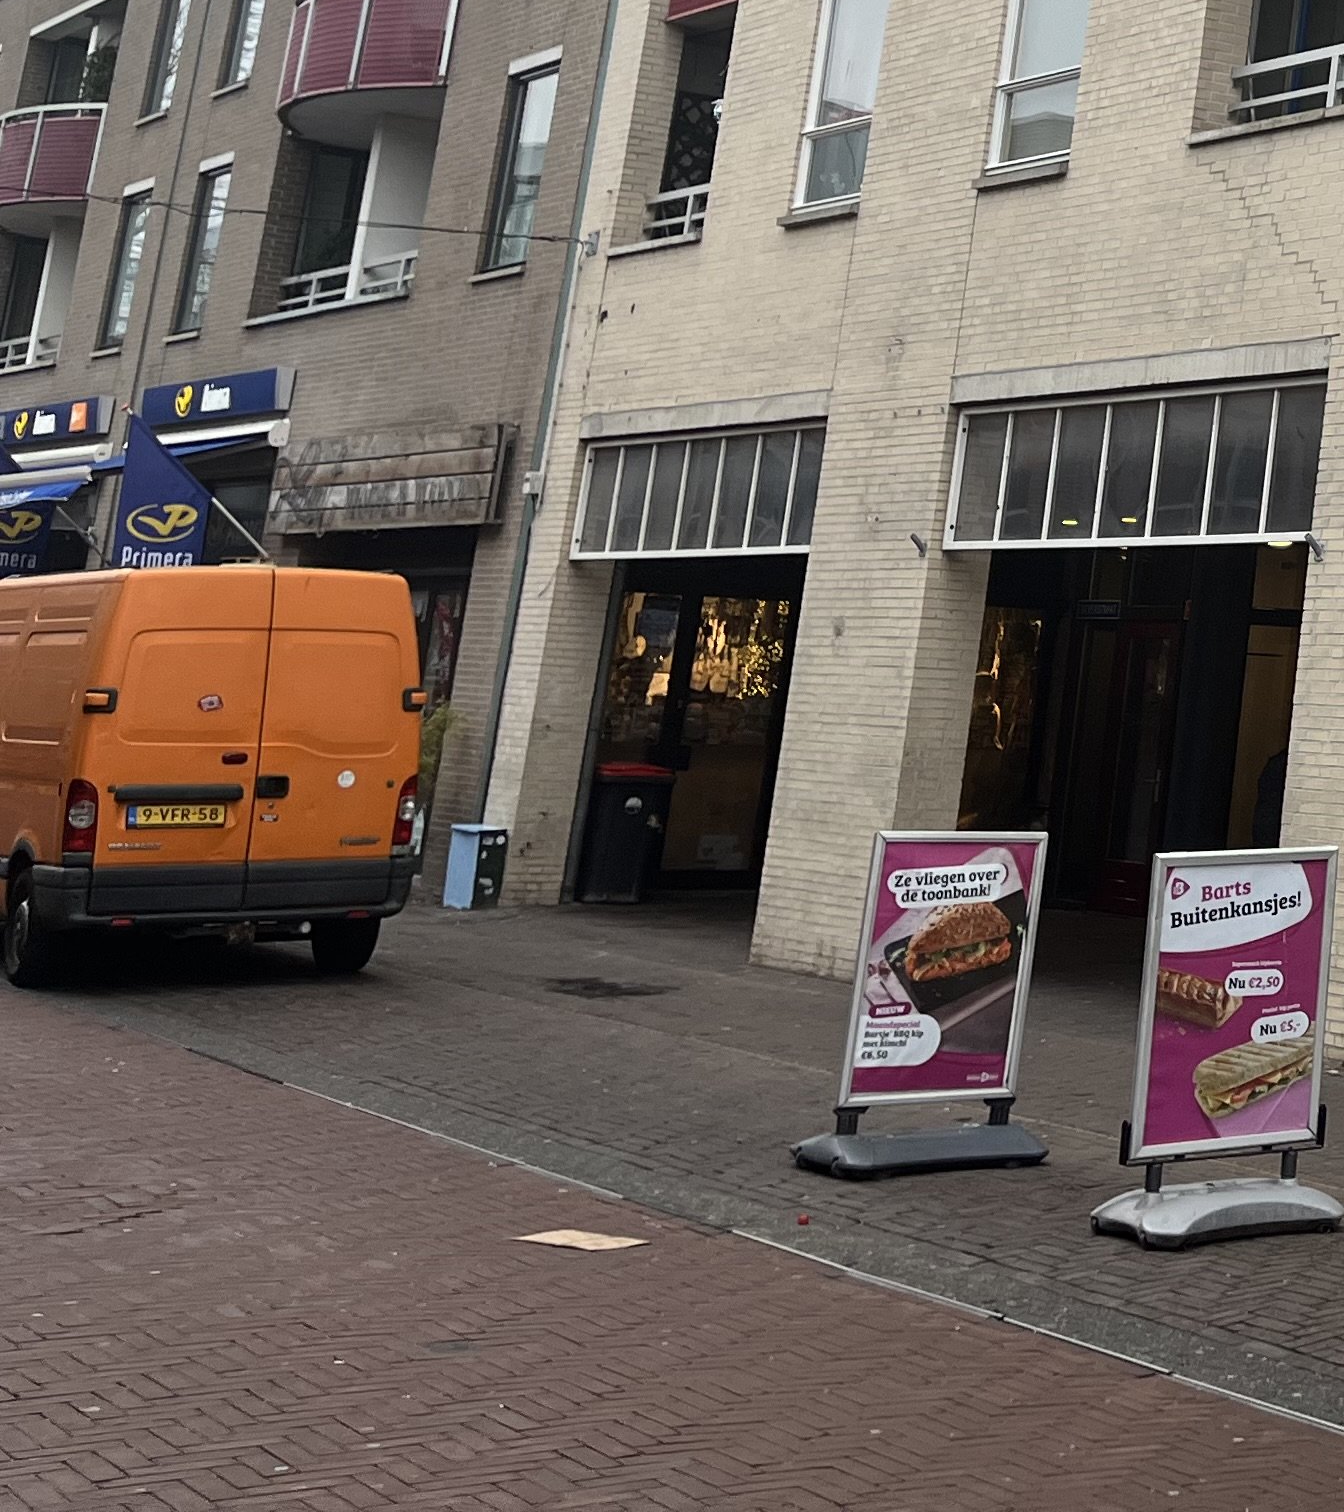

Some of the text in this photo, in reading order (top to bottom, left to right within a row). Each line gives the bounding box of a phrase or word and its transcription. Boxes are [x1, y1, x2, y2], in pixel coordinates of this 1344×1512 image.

[121, 547, 193, 568] Primera
[142, 807, 220, 822] 9-VFR-58
[895, 870, 1000, 887] Ze vliegen over
[901, 884, 991, 902] de toonbank!
[1201, 881, 1251, 902] Barts
[1170, 891, 1302, 929] Buitenkansjes!
[1228, 977, 1280, 990] Nu €2,50
[1260, 1024, 1277, 1036] Nu
